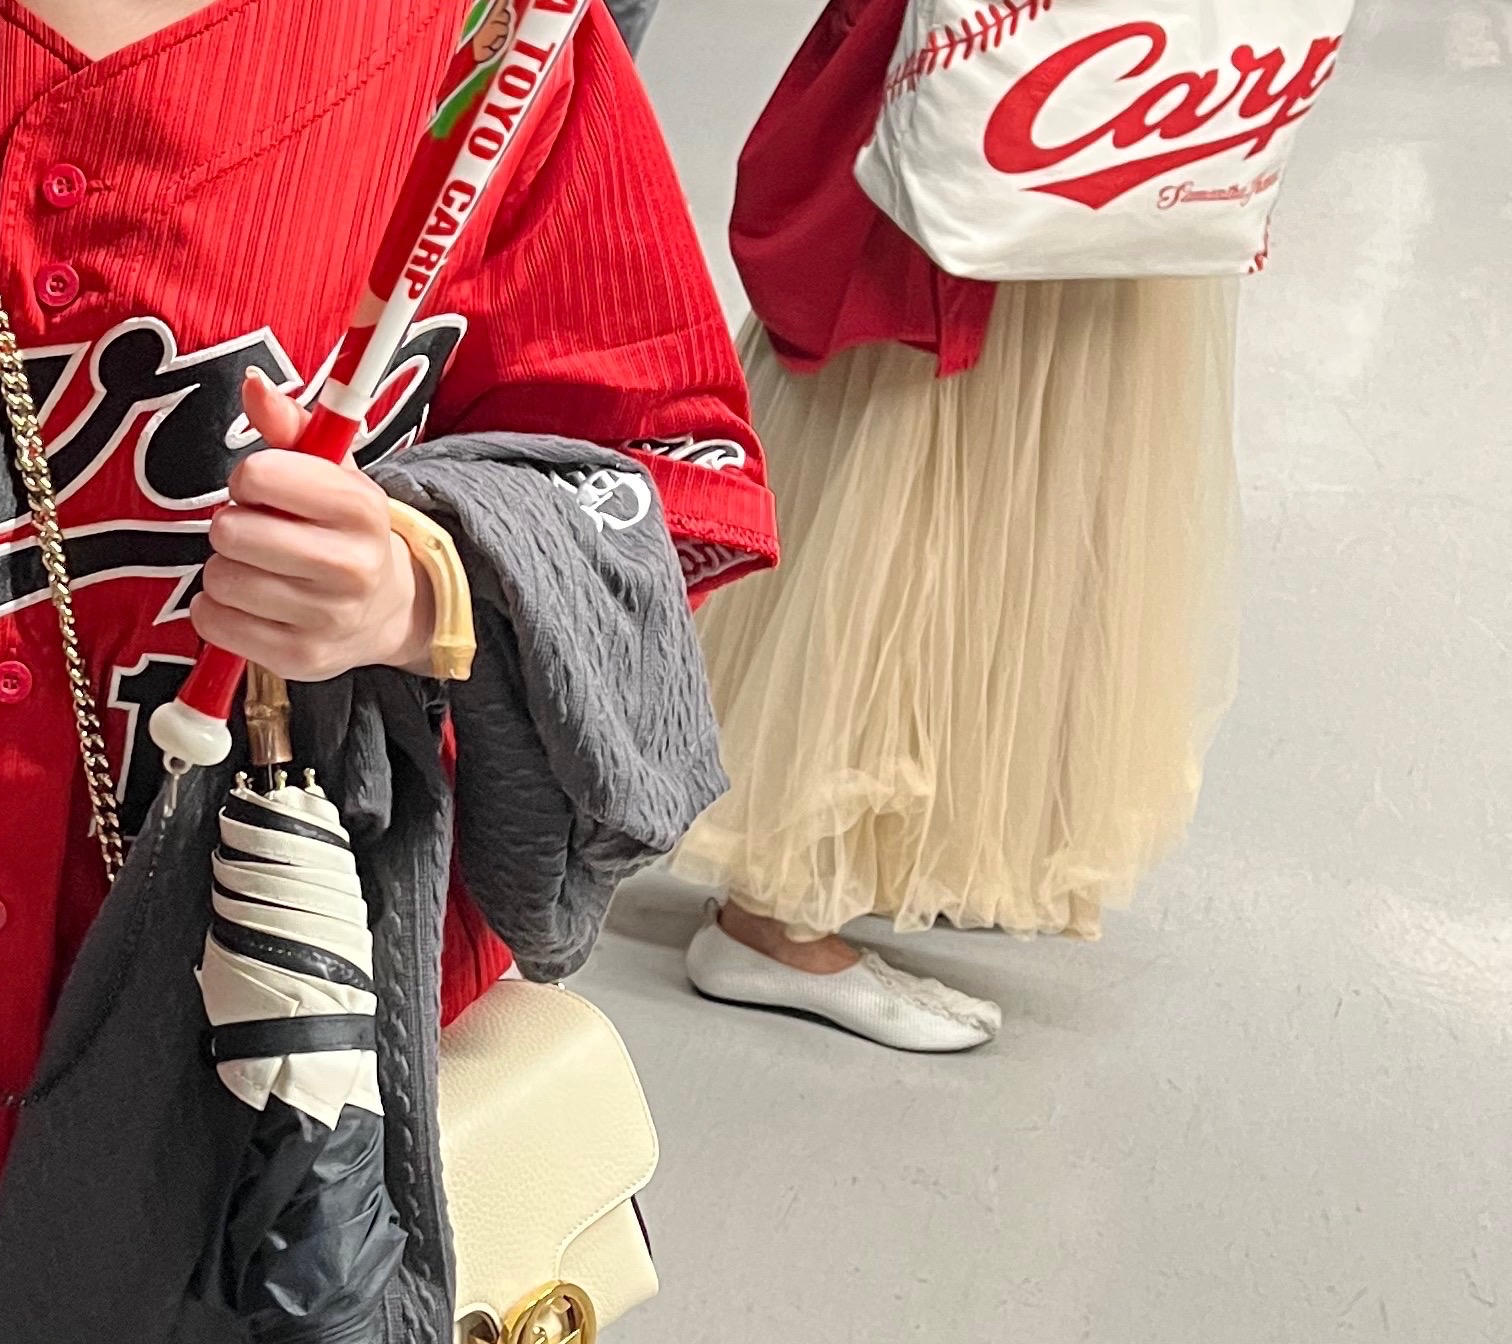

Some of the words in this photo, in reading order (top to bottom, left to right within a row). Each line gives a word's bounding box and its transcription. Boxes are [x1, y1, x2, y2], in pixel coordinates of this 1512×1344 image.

[468, 38, 556, 162] TOYO
[983, 21, 1342, 209] Carp
[402, 178, 478, 301] CARP
